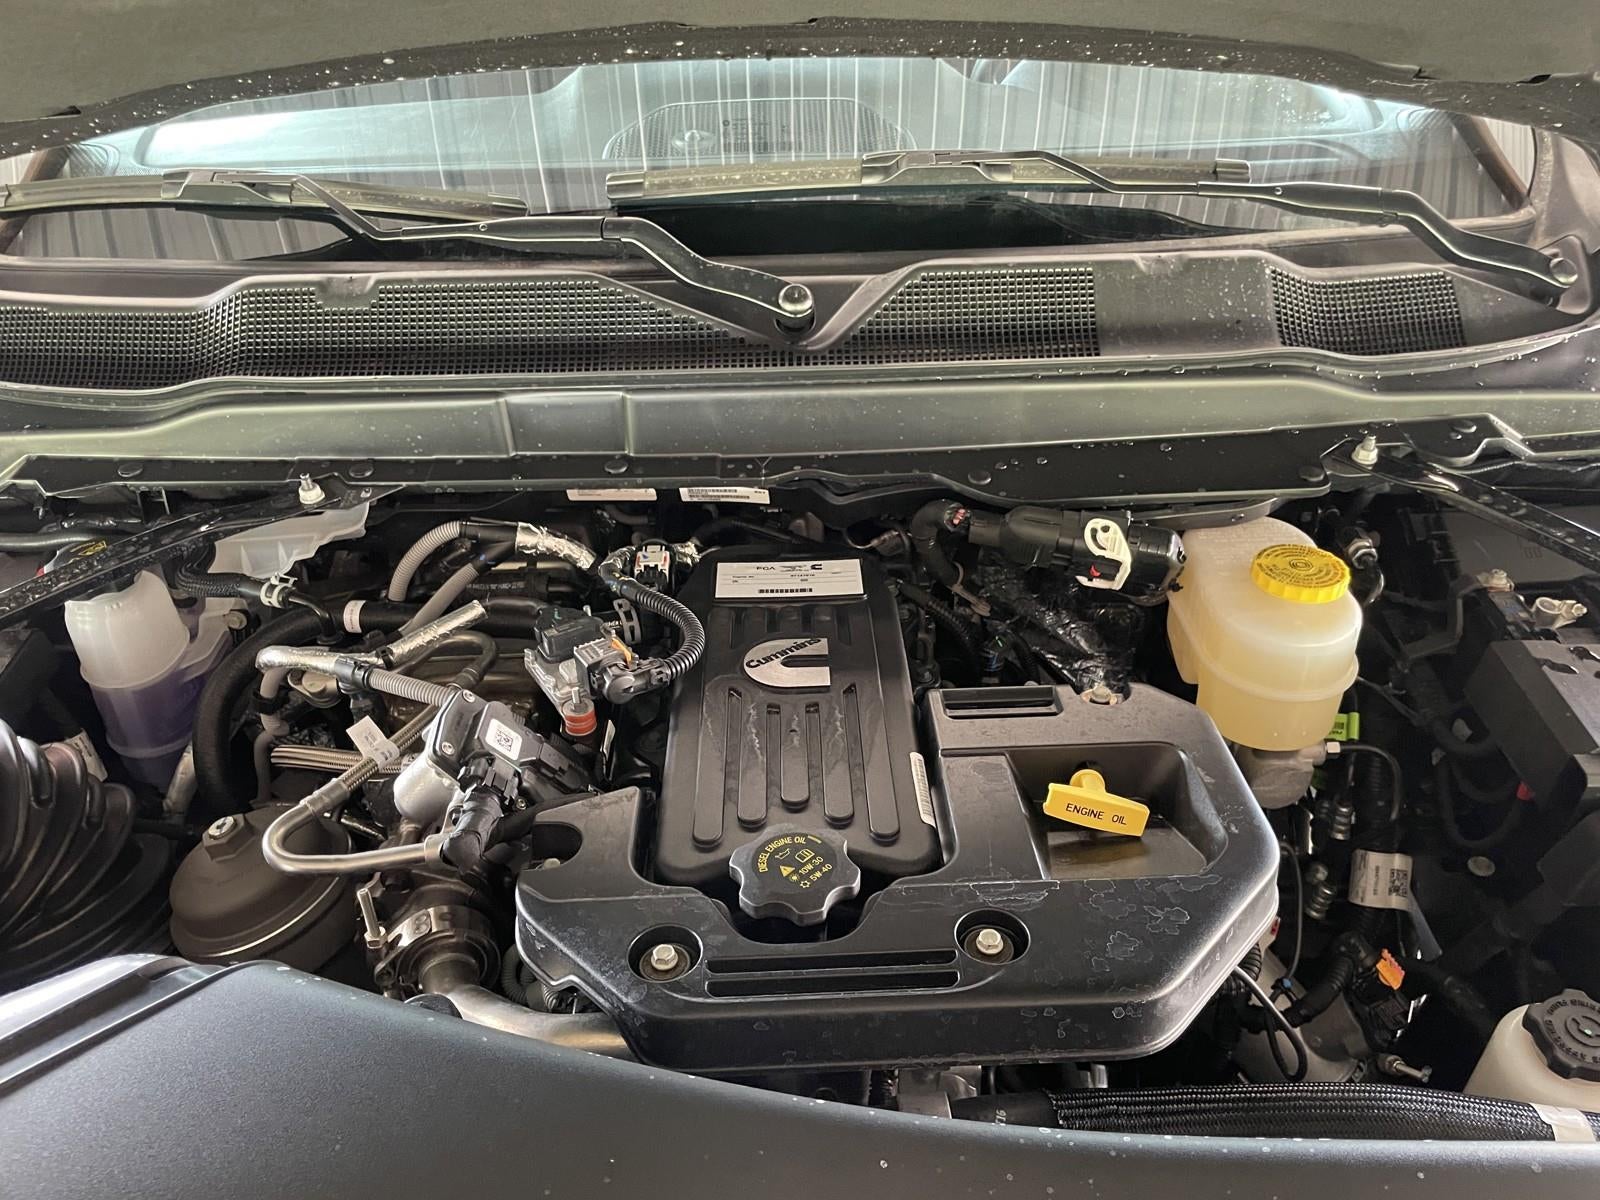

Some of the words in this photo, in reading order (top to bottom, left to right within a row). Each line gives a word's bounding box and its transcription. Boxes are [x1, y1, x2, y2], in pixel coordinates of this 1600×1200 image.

[1066, 803, 1105, 820] ENGINE
[1111, 814, 1127, 825] OIL
[758, 852, 770, 872] DIESEL
[765, 836, 793, 852] ENGINE
[794, 836, 807, 844] OIL
[799, 856, 824, 875] 10W-30
[809, 863, 832, 882] 5W-40
